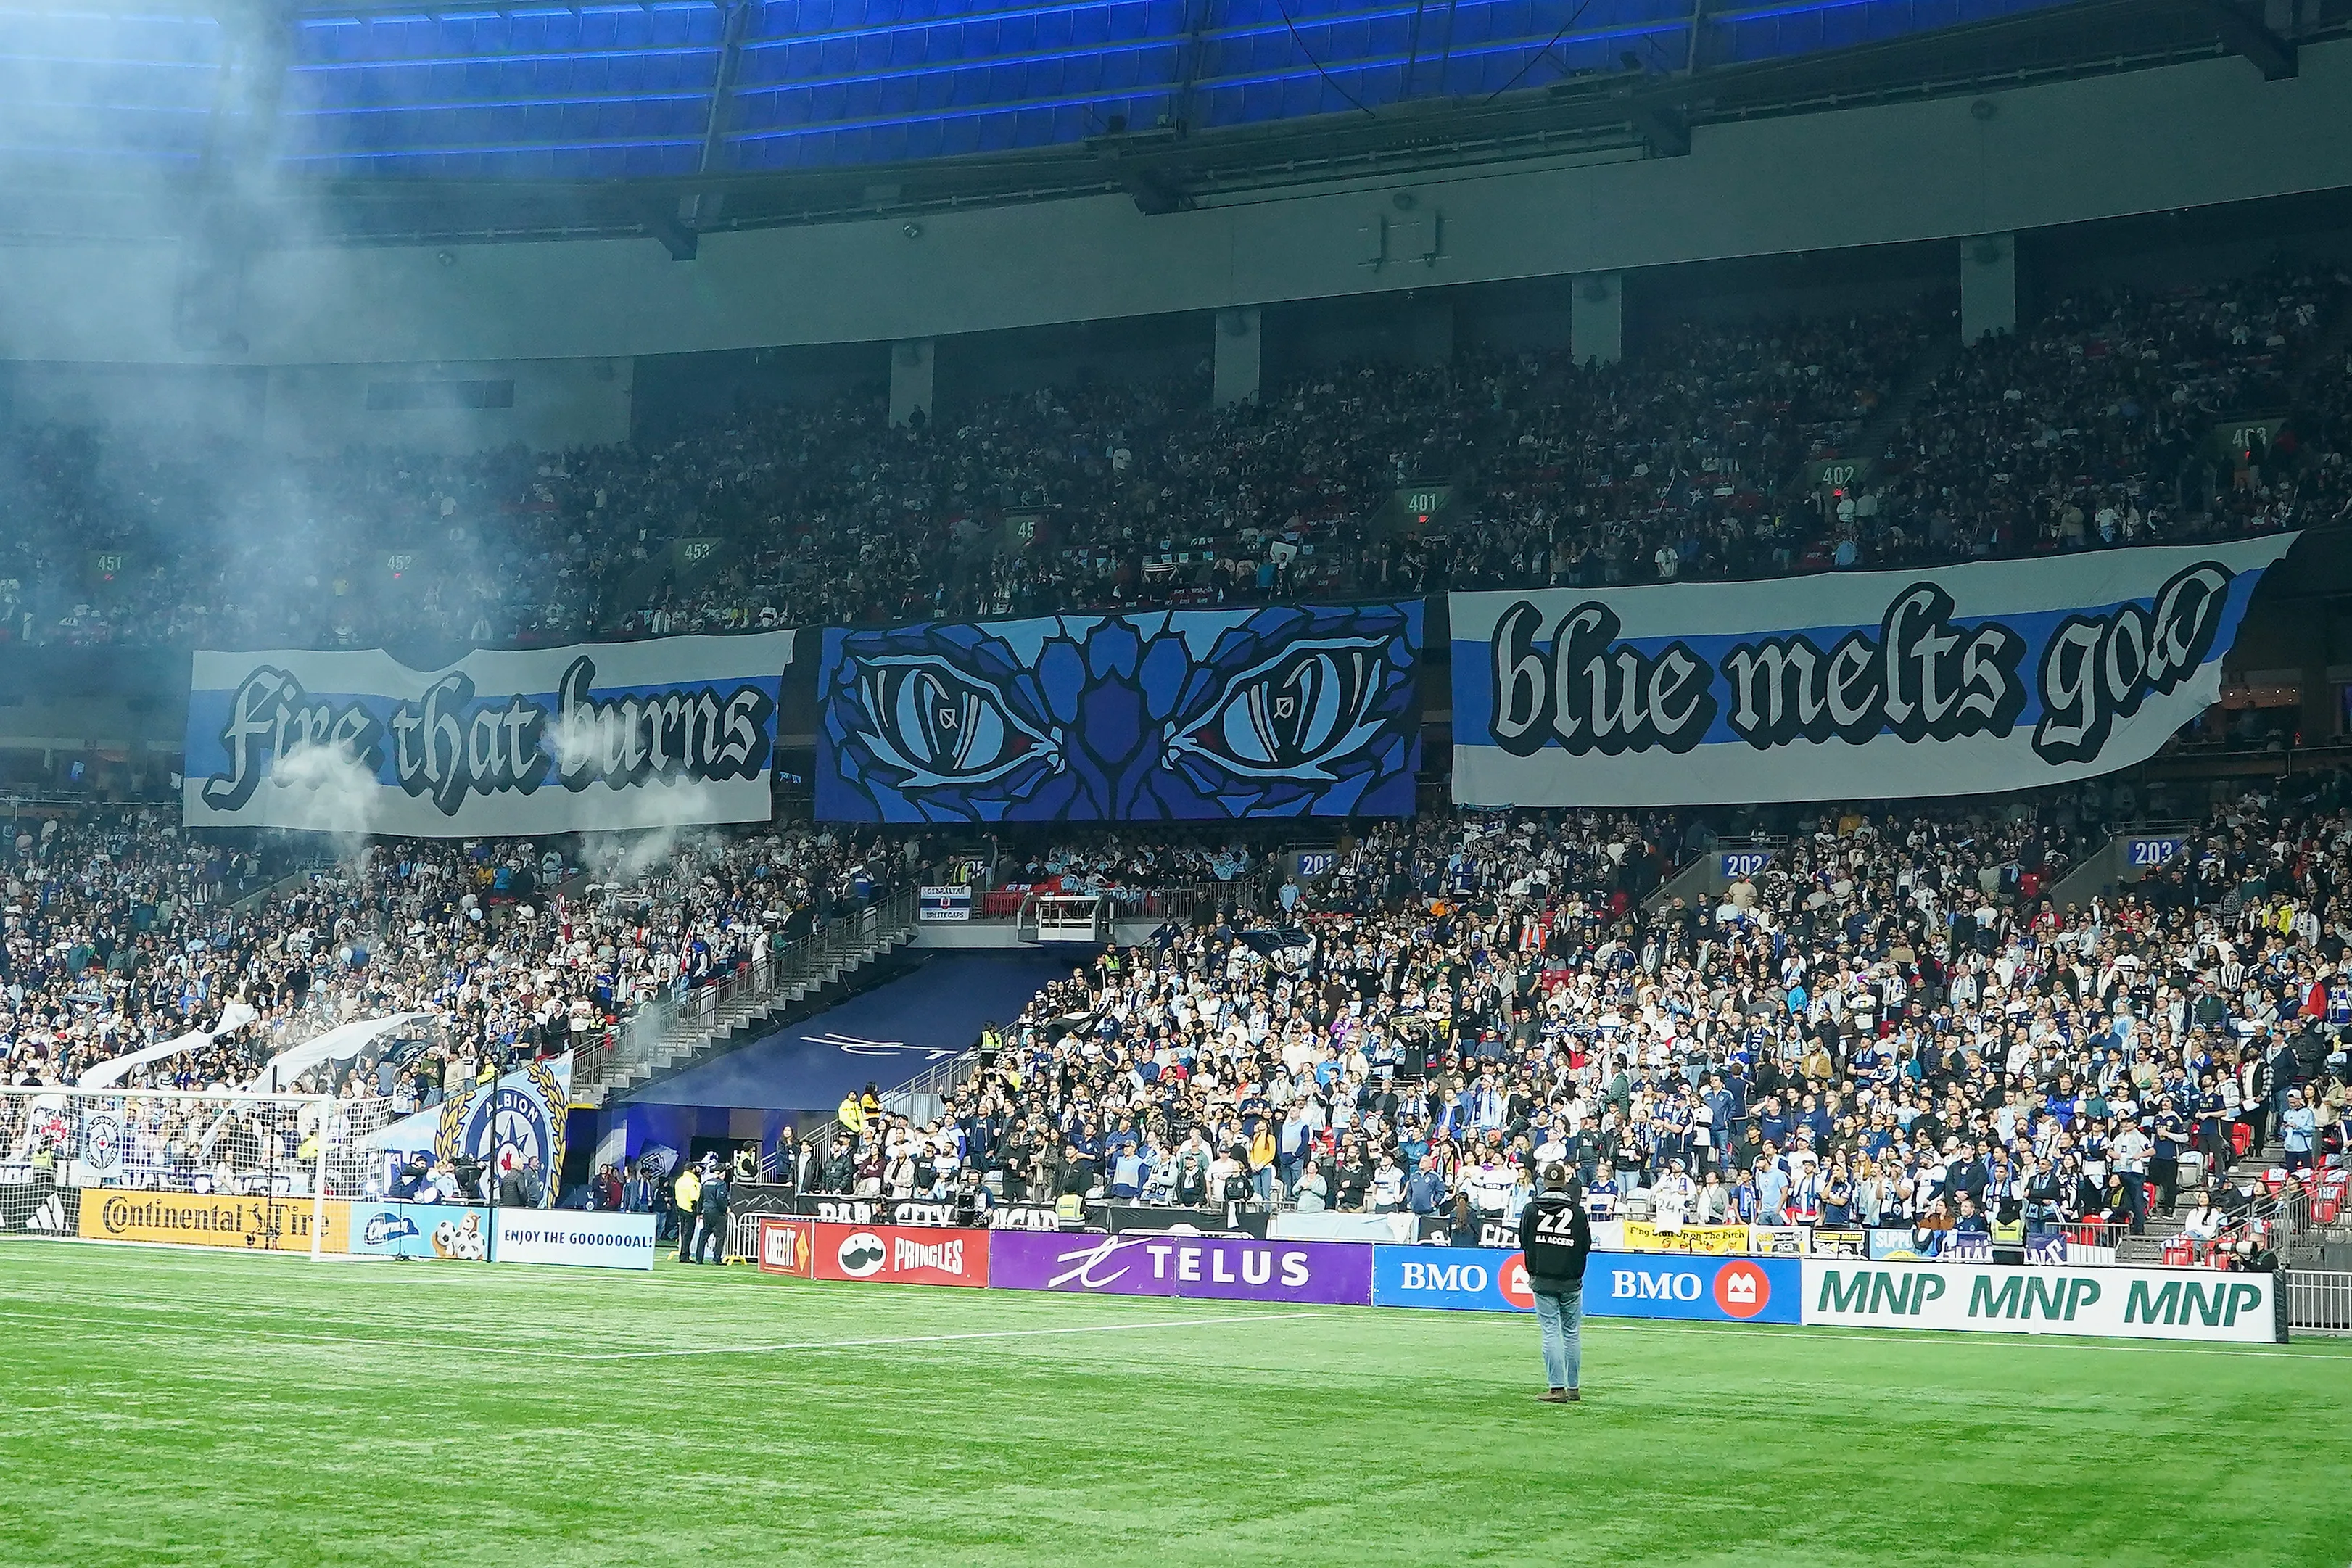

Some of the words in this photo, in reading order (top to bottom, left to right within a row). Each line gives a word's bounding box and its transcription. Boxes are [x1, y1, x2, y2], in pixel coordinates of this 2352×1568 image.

[1823, 466, 1854, 484] 402
[1408, 493, 1436, 512] 401
[97, 555, 122, 572] 451
[1490, 600, 1716, 756] blue
[1721, 582, 2025, 748] melts
[392, 670, 548, 816] that
[557, 656, 775, 792] burns
[1303, 854, 1332, 876] 201
[1728, 854, 1763, 877] 202
[2134, 841, 2173, 865] 203
[485, 1093, 539, 1123] ALBION
[102, 1196, 244, 1234] Continental
[1536, 1208, 1574, 1234] 22
[505, 1230, 540, 1245] ENJOY
[544, 1231, 565, 1243] THE
[569, 1233, 653, 1248] GOOOOOOAL!
[1547, 1236, 1575, 1247] ACCESS
[1704, 1231, 1721, 1239] The
[1722, 1229, 1745, 1239] Pitch
[1876, 1231, 1913, 1248] SUPPO
[894, 1237, 963, 1275] PRINGLES
[1147, 1244, 1311, 1287] TELUS
[1400, 1261, 1489, 1293] BMO
[1611, 1270, 1703, 1302] BMO
[1817, 1271, 1947, 1316] MNP
[1968, 1274, 2102, 1321] MNP
[2124, 1279, 2263, 1327] MNP
